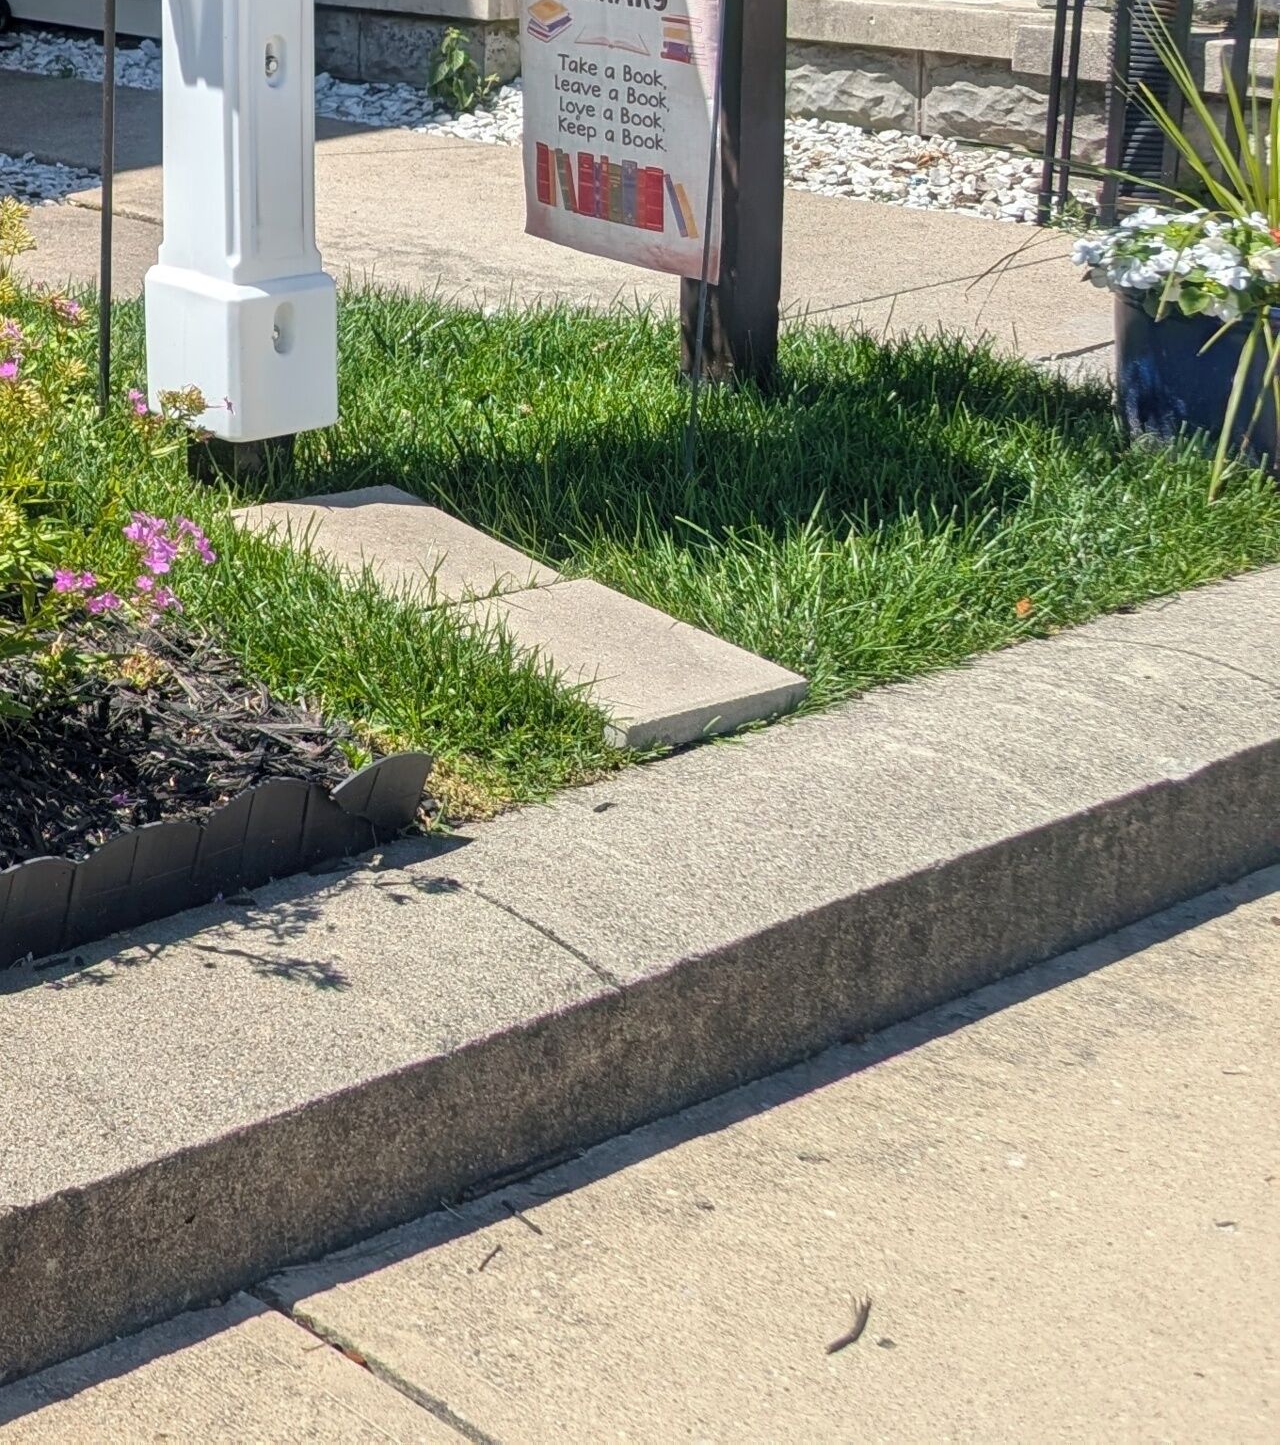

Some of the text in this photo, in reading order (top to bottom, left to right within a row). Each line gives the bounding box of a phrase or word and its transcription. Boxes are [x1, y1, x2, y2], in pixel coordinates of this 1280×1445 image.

[557, 53, 598, 76] Take
[604, 66, 615, 80] a
[554, 74, 670, 113] Leave a Book,
[559, 96, 665, 133] Love a Book,
[558, 115, 667, 152] Keep a Book.
